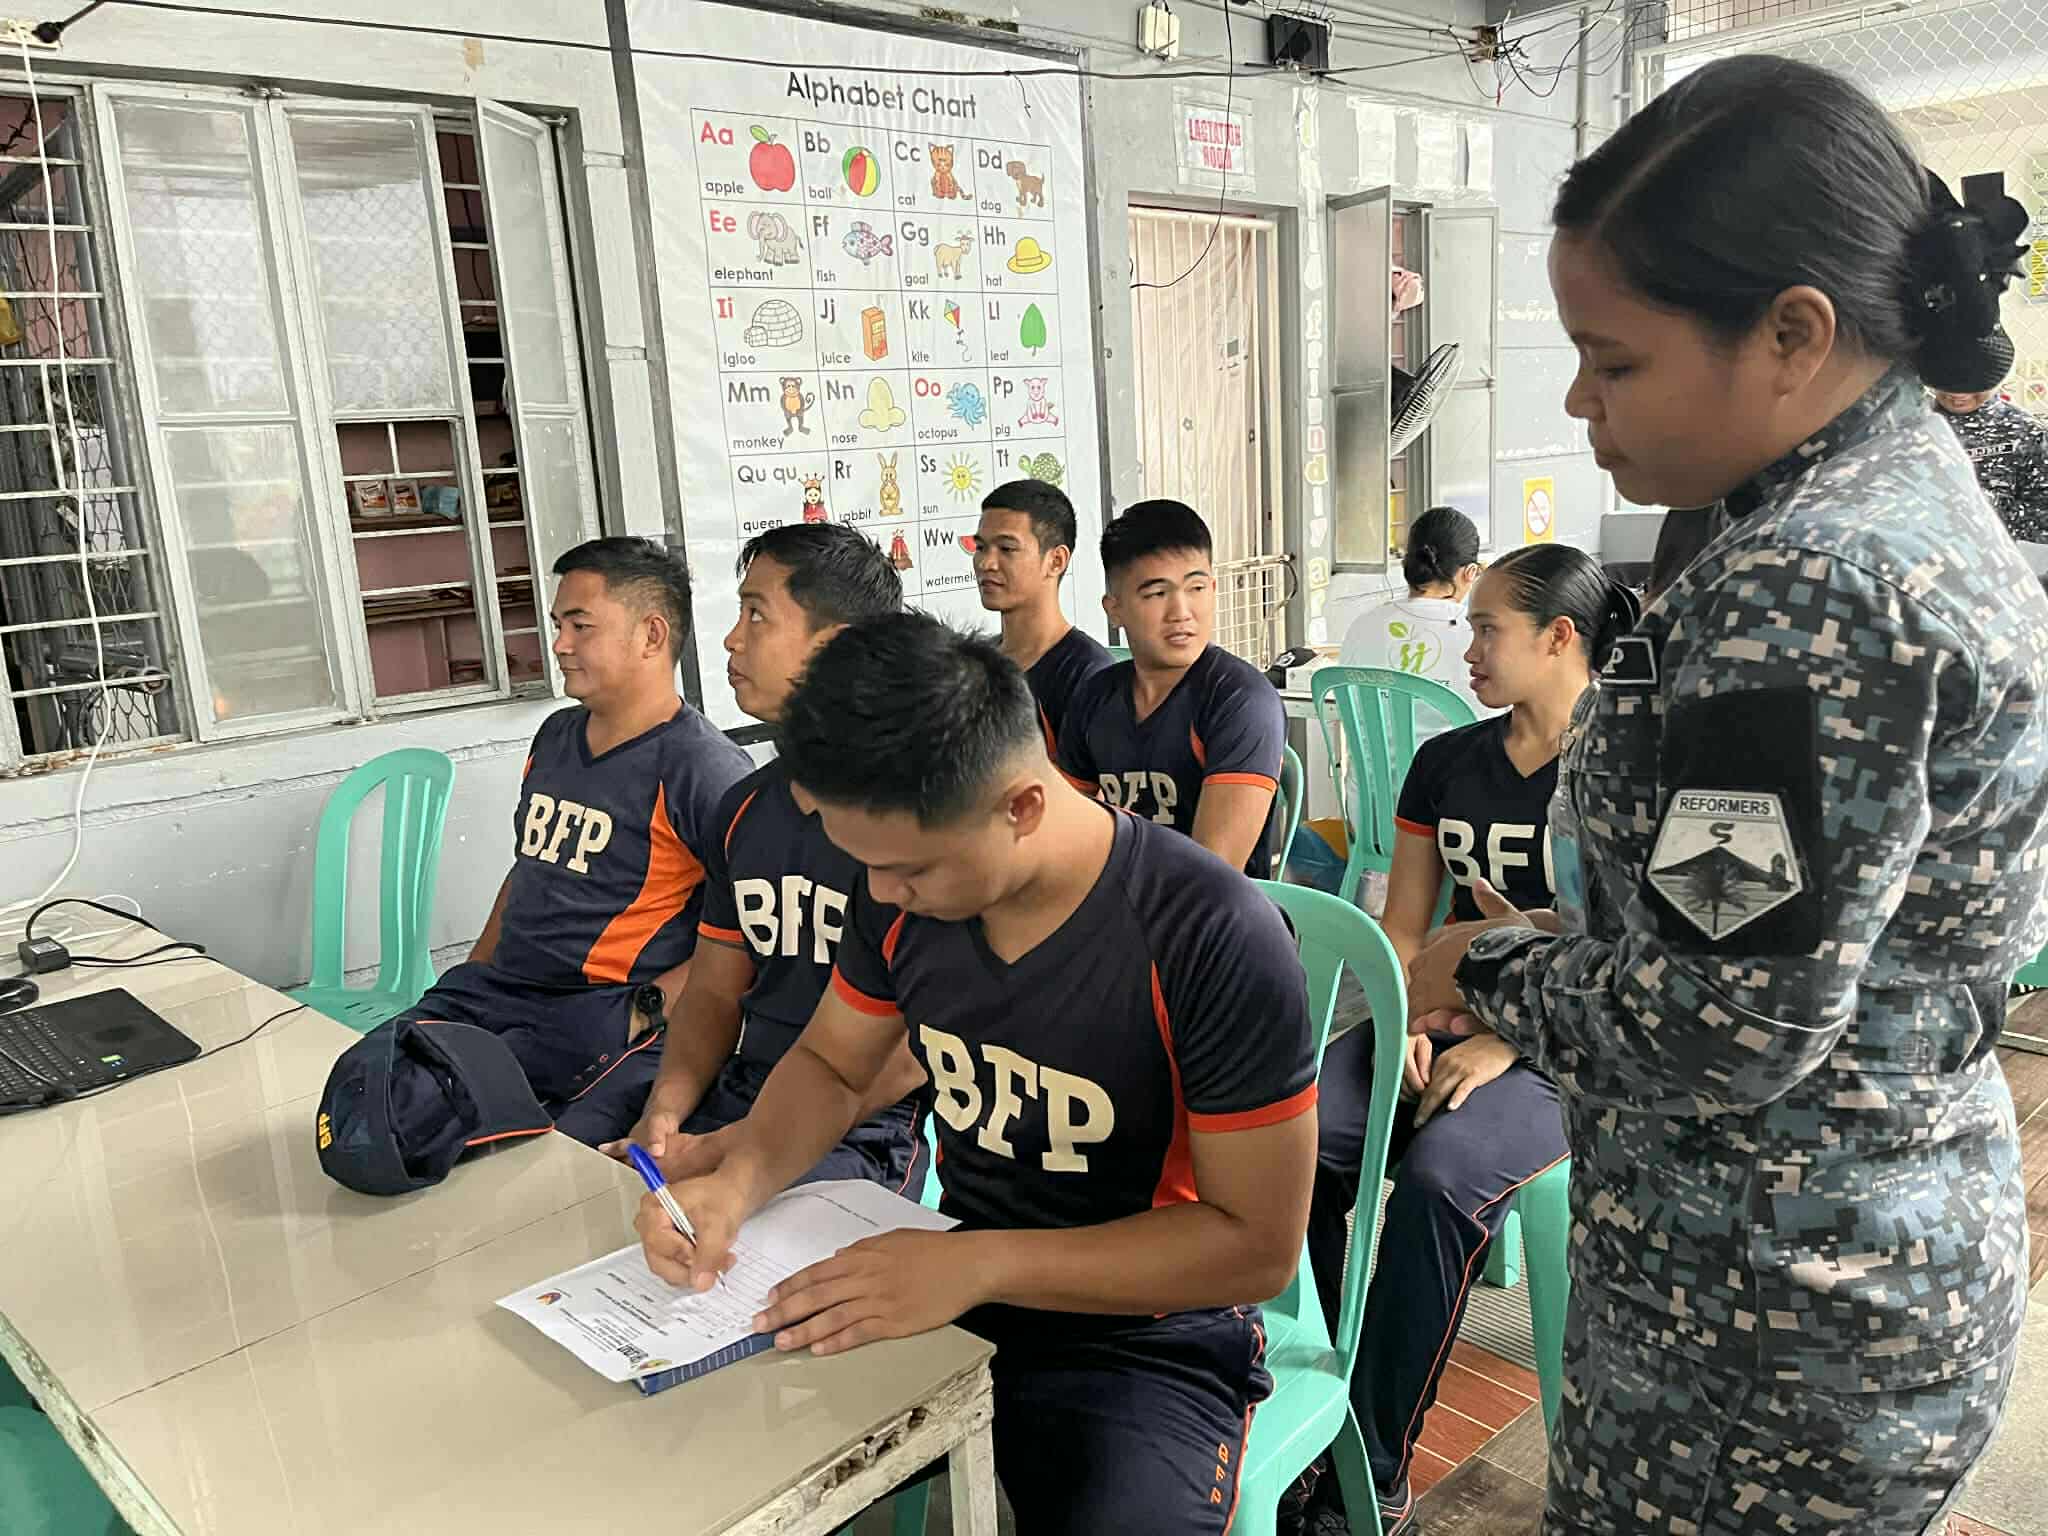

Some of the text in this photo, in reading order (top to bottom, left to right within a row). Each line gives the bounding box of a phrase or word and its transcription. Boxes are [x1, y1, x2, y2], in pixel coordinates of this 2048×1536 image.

[787, 72, 976, 119] Alphabet Chart
[700, 121, 734, 146] Aa
[804, 132, 831, 153] Bb
[894, 142, 921, 163] Cc
[978, 149, 1002, 170] Dd
[705, 180, 745, 196] apple
[808, 186, 832, 199] ball
[898, 194, 917, 206] cat
[980, 199, 1002, 214] dog
[710, 210, 737, 232] Ee
[813, 215, 830, 236] Ff
[900, 222, 930, 246] Gg
[984, 227, 1006, 246] Hh
[714, 267, 774, 282] elephant
[816, 269, 836, 283] fish
[904, 273, 929, 287] goat
[985, 274, 1003, 287] hat
[716, 297, 734, 319] Ii
[820, 298, 836, 324] Jj
[908, 300, 930, 320] Kk
[988, 301, 1001, 320] Ll
[821, 351, 851, 367] juice
[912, 351, 929, 363] kite
[990, 351, 1010, 362] leaf
[728, 382, 771, 403] Mm
[826, 380, 855, 400] Nn
[914, 378, 942, 397] Oo
[993, 376, 1014, 400] Pp
[831, 432, 858, 444] nose
[918, 427, 959, 440] octopus
[995, 425, 1012, 438] pig
[733, 435, 785, 450] monkey
[920, 454, 937, 474] Ss
[996, 449, 1010, 468] Tt
[737, 464, 767, 483] Qu
[834, 460, 852, 480] Rr
[922, 504, 939, 514] sun
[743, 518, 783, 532] queen
[923, 528, 954, 547] Ww
[925, 571, 976, 588] watermel
[1099, 771, 1178, 825] BFP
[1679, 796, 1771, 815] REFORMERS
[520, 792, 612, 874] BFP
[1438, 817, 1556, 893] BF
[919, 1024, 1115, 1172] BFP
